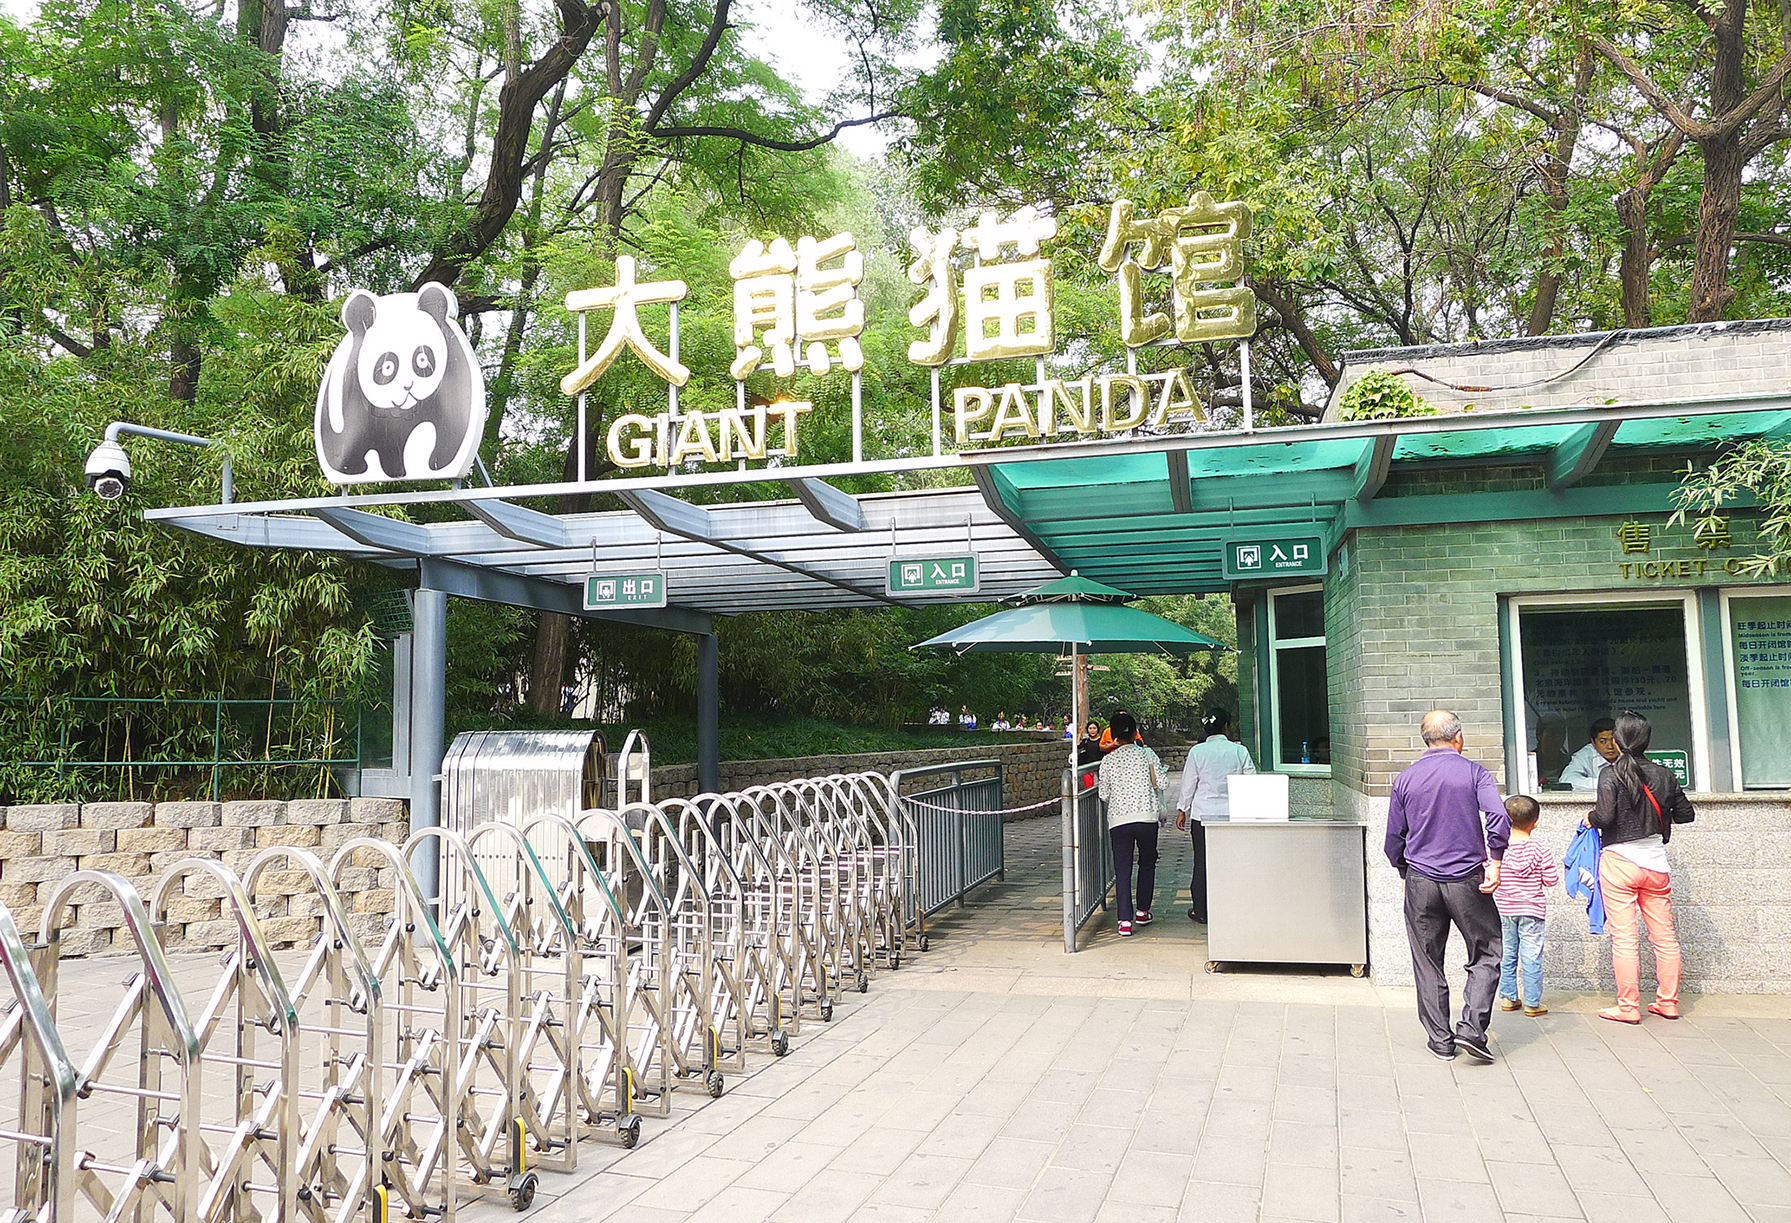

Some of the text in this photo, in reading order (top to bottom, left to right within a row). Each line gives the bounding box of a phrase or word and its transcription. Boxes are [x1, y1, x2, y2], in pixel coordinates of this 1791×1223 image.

[560, 190, 1257, 396] 大熊猫馆
[606, 367, 1208, 468] GIANT PANDA
[1269, 544, 1309, 561] 入口
[930, 563, 966, 579] 入口
[1619, 558, 1707, 579] TICKET
[622, 579, 654, 595] 出口
[935, 578, 960, 586] ENTRANCE
[1742, 679, 1791, 688] 每日开闭馆
